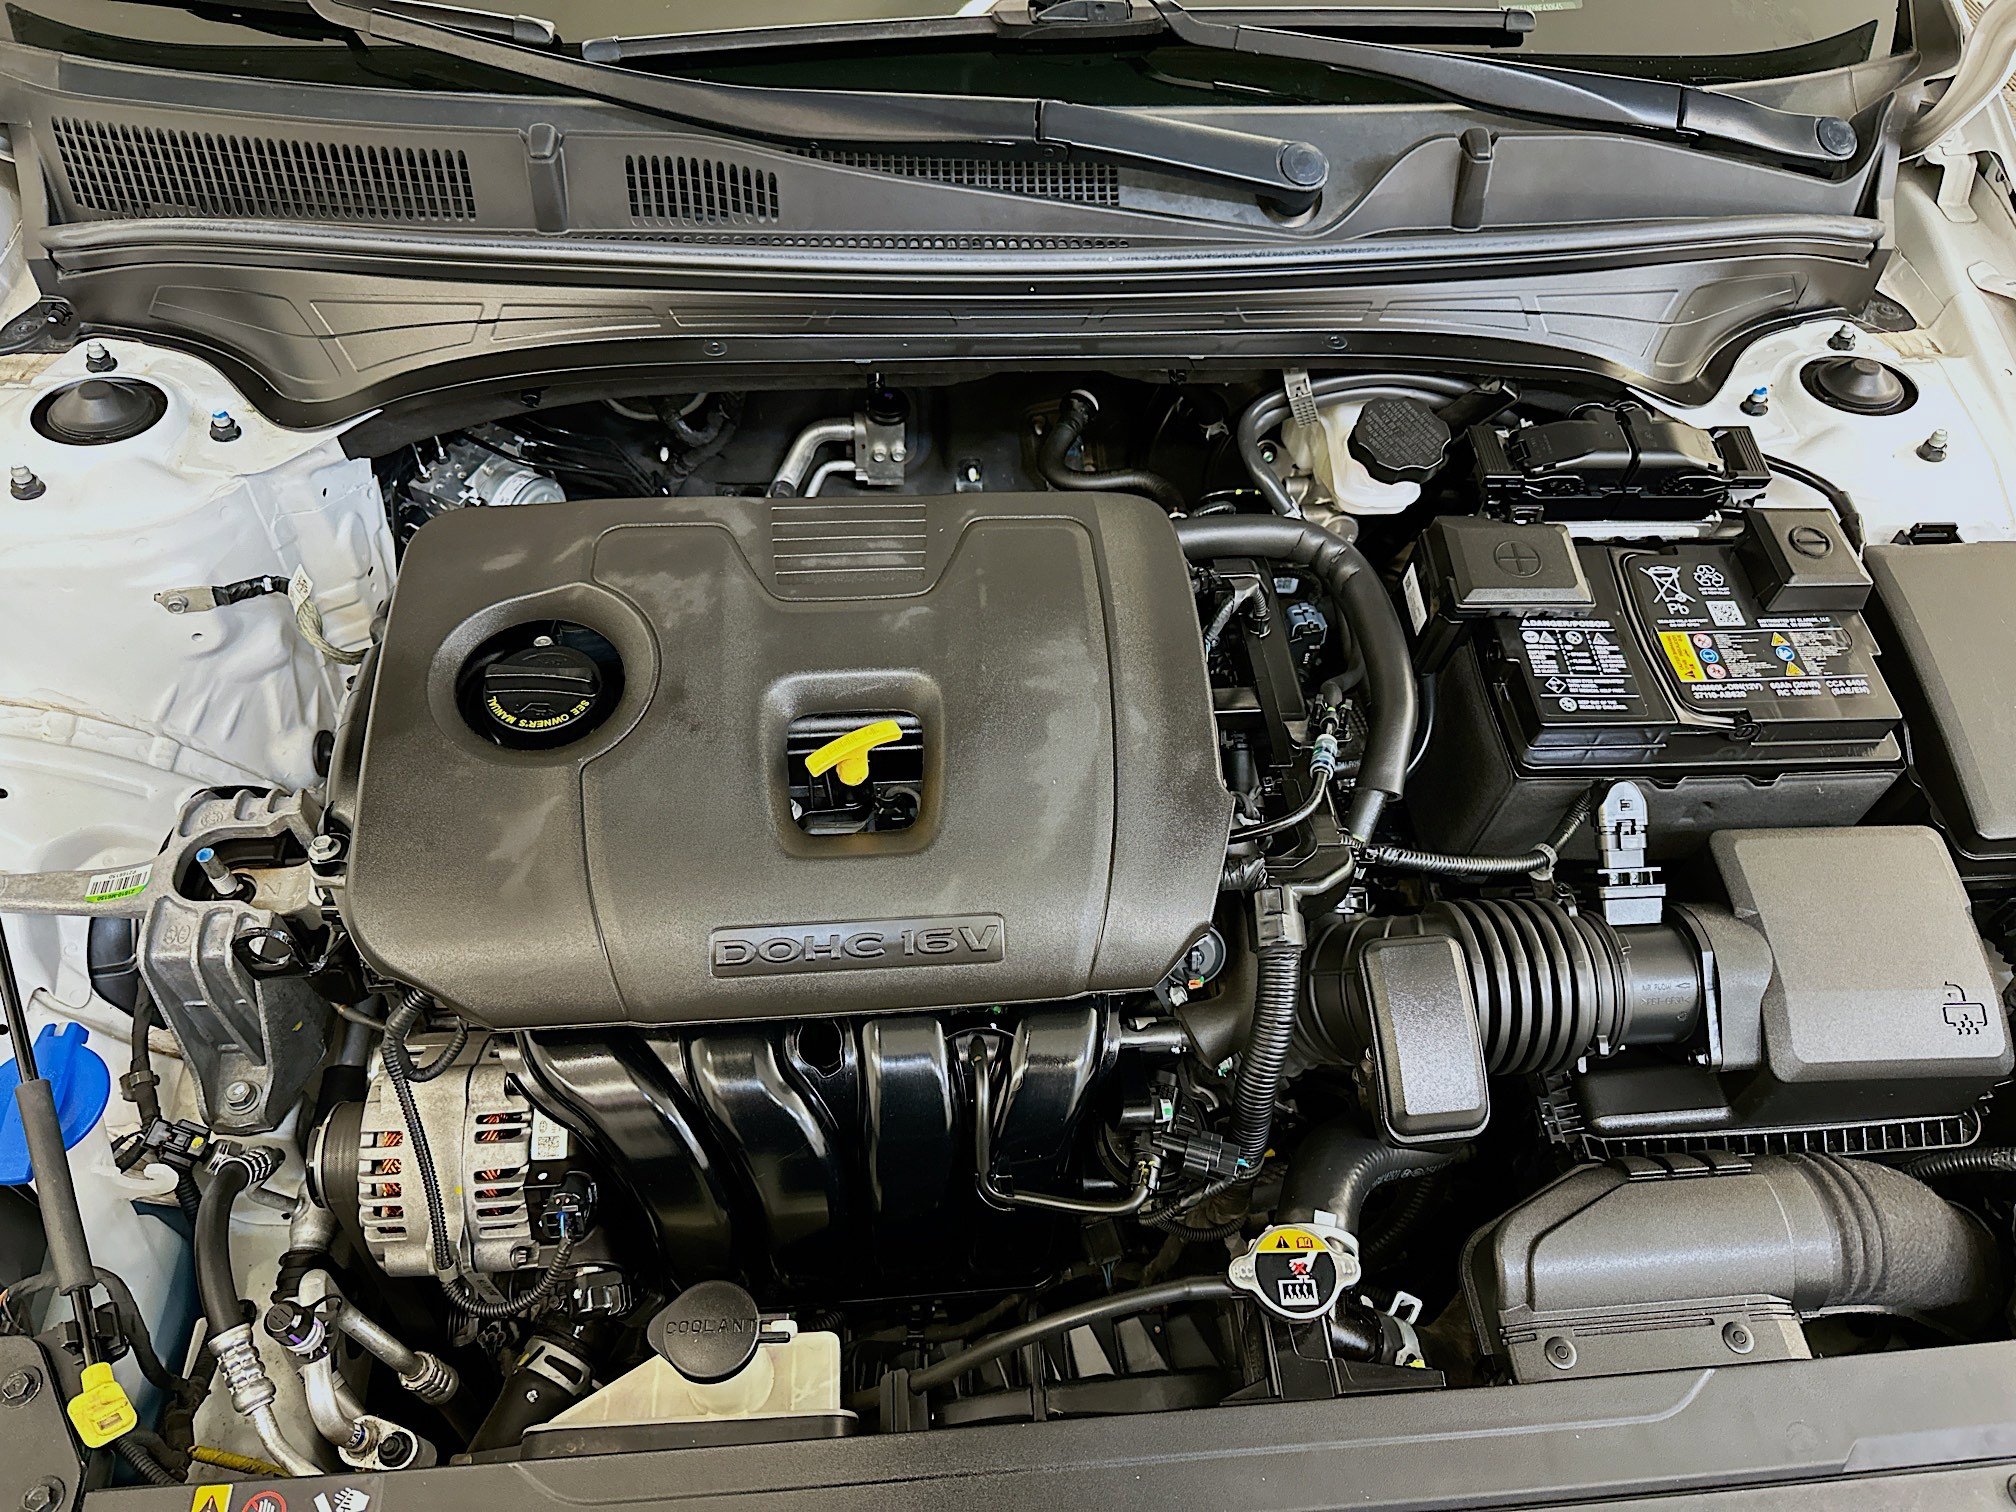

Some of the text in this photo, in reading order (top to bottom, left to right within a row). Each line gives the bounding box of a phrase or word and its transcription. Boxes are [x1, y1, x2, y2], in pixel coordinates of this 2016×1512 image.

[1666, 602, 1690, 615] Pb
[1825, 680, 1846, 688] CCA
[1776, 689, 1791, 697] RC
[486, 695, 590, 728] SEE OWNER'S MANUAL
[714, 924, 999, 967] DOHC 16V
[665, 1318, 757, 1335] COOLANT
